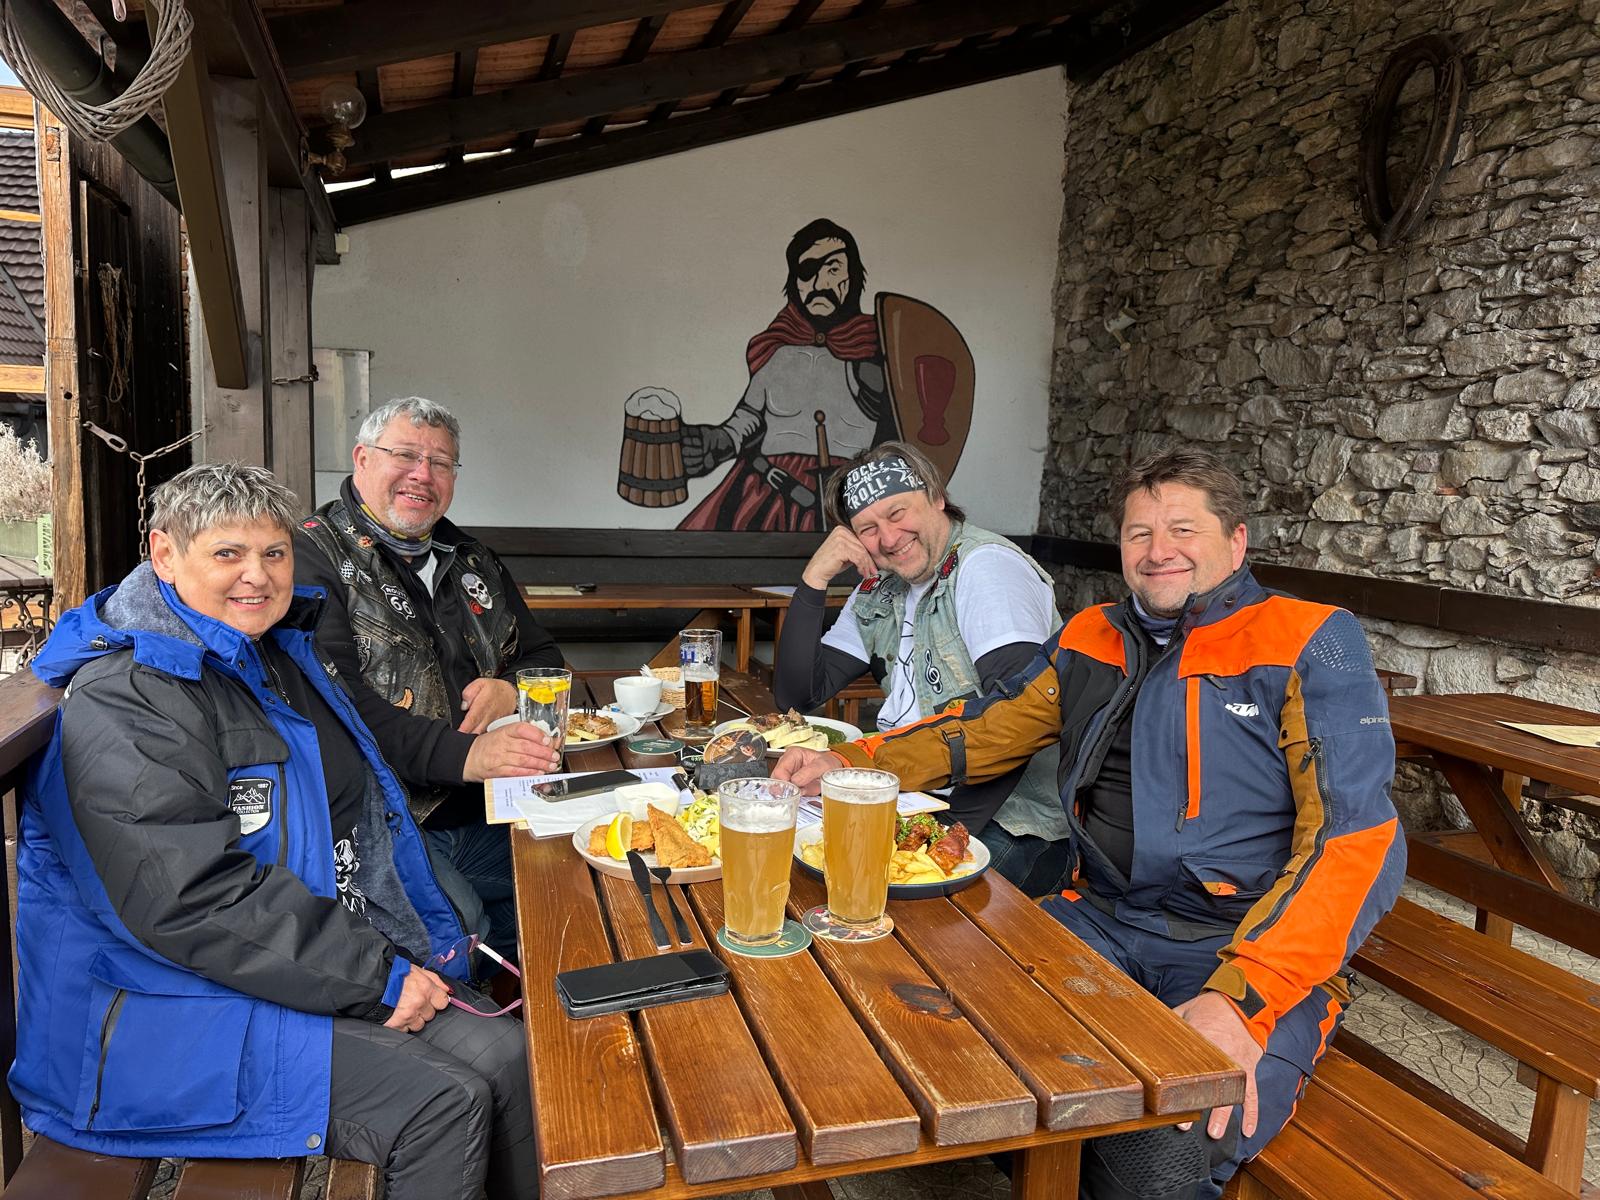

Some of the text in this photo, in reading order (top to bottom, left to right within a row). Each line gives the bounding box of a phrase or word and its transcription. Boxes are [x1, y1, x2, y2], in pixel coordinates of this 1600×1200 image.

[846, 461, 878, 489] ROCK
[851, 478, 887, 510] ROLL
[391, 597, 413, 615] 66
[1225, 703, 1259, 717] KTM
[233, 804, 264, 812] FASHION
